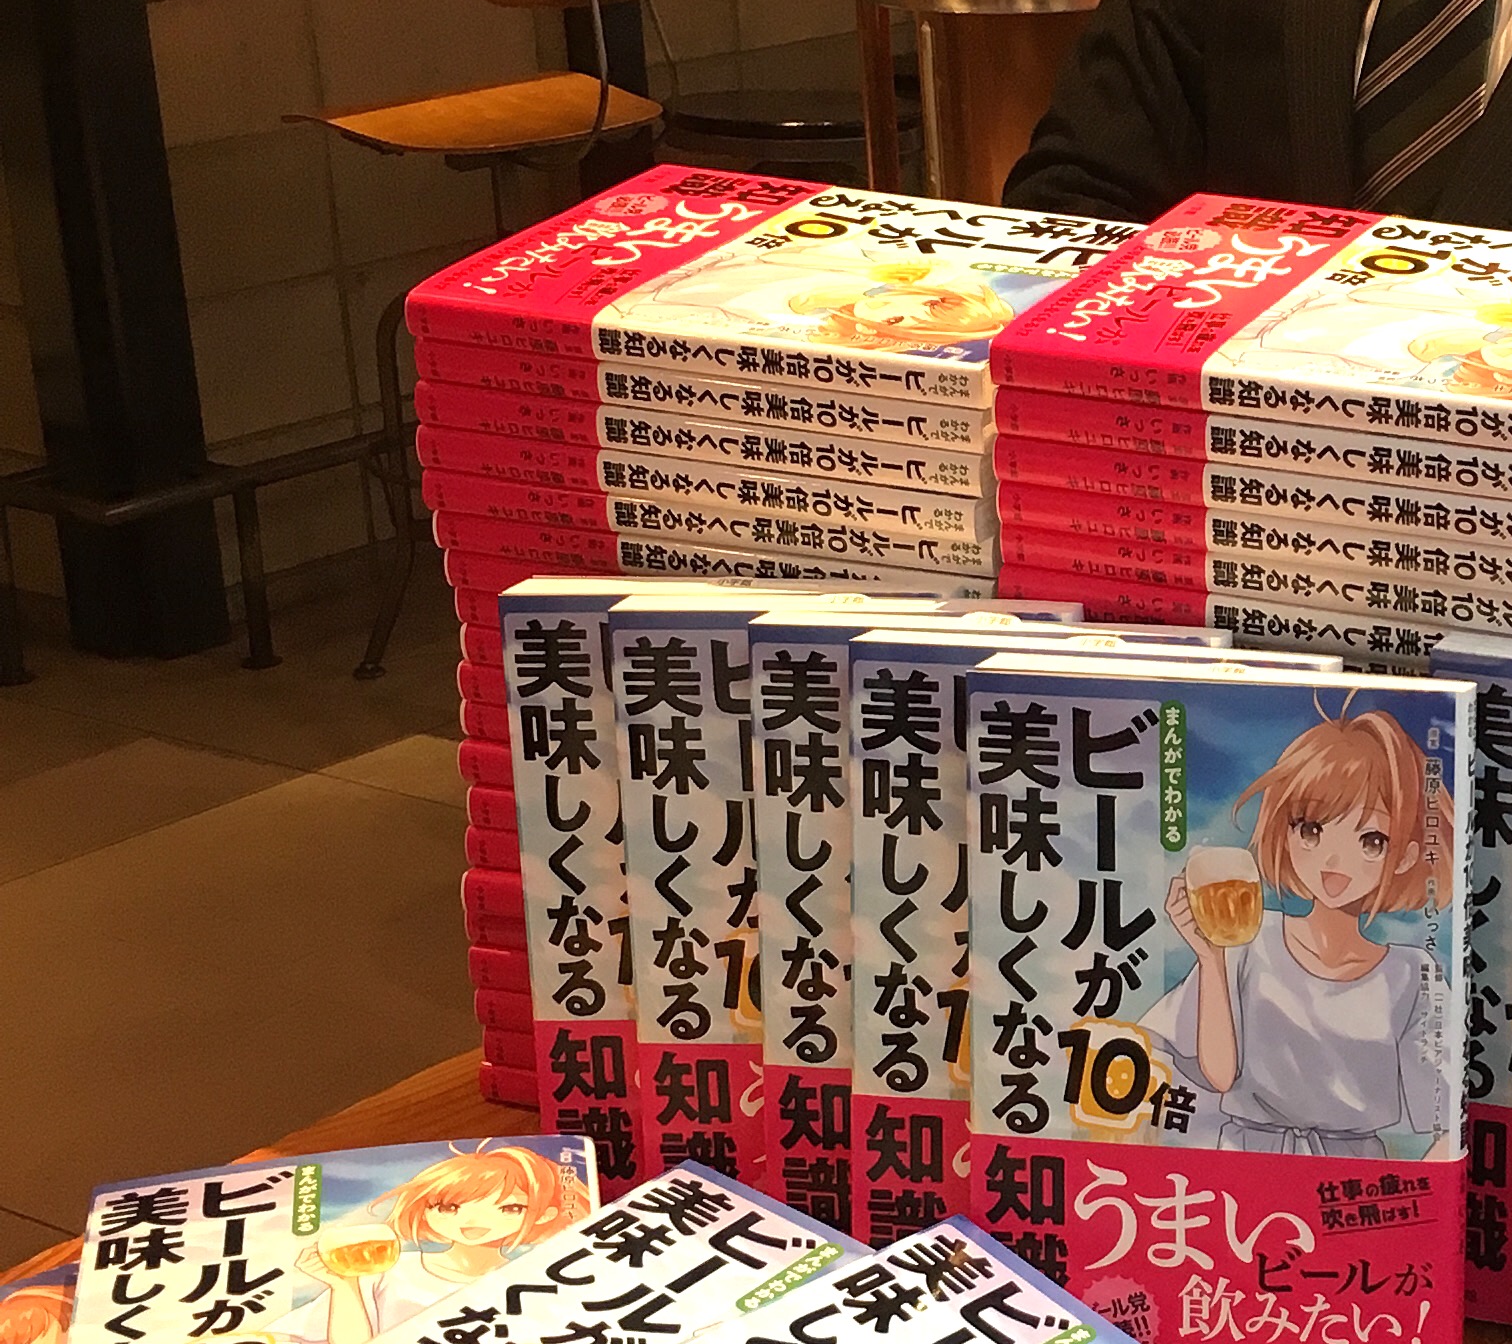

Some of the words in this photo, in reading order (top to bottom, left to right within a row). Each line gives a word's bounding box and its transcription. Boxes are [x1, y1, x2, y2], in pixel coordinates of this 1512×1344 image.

[1173, 233, 1330, 308] うまい
[1164, 707, 1182, 844] まんがでわかる
[1424, 757, 1443, 867] 藤原ヒロユキ
[1057, 706, 1197, 1133] ビールが10倍
[1074, 1158, 1316, 1271] うまい
[1316, 1174, 1432, 1204] 仕事の疲れを
[1257, 1246, 1433, 1298] ビールが
